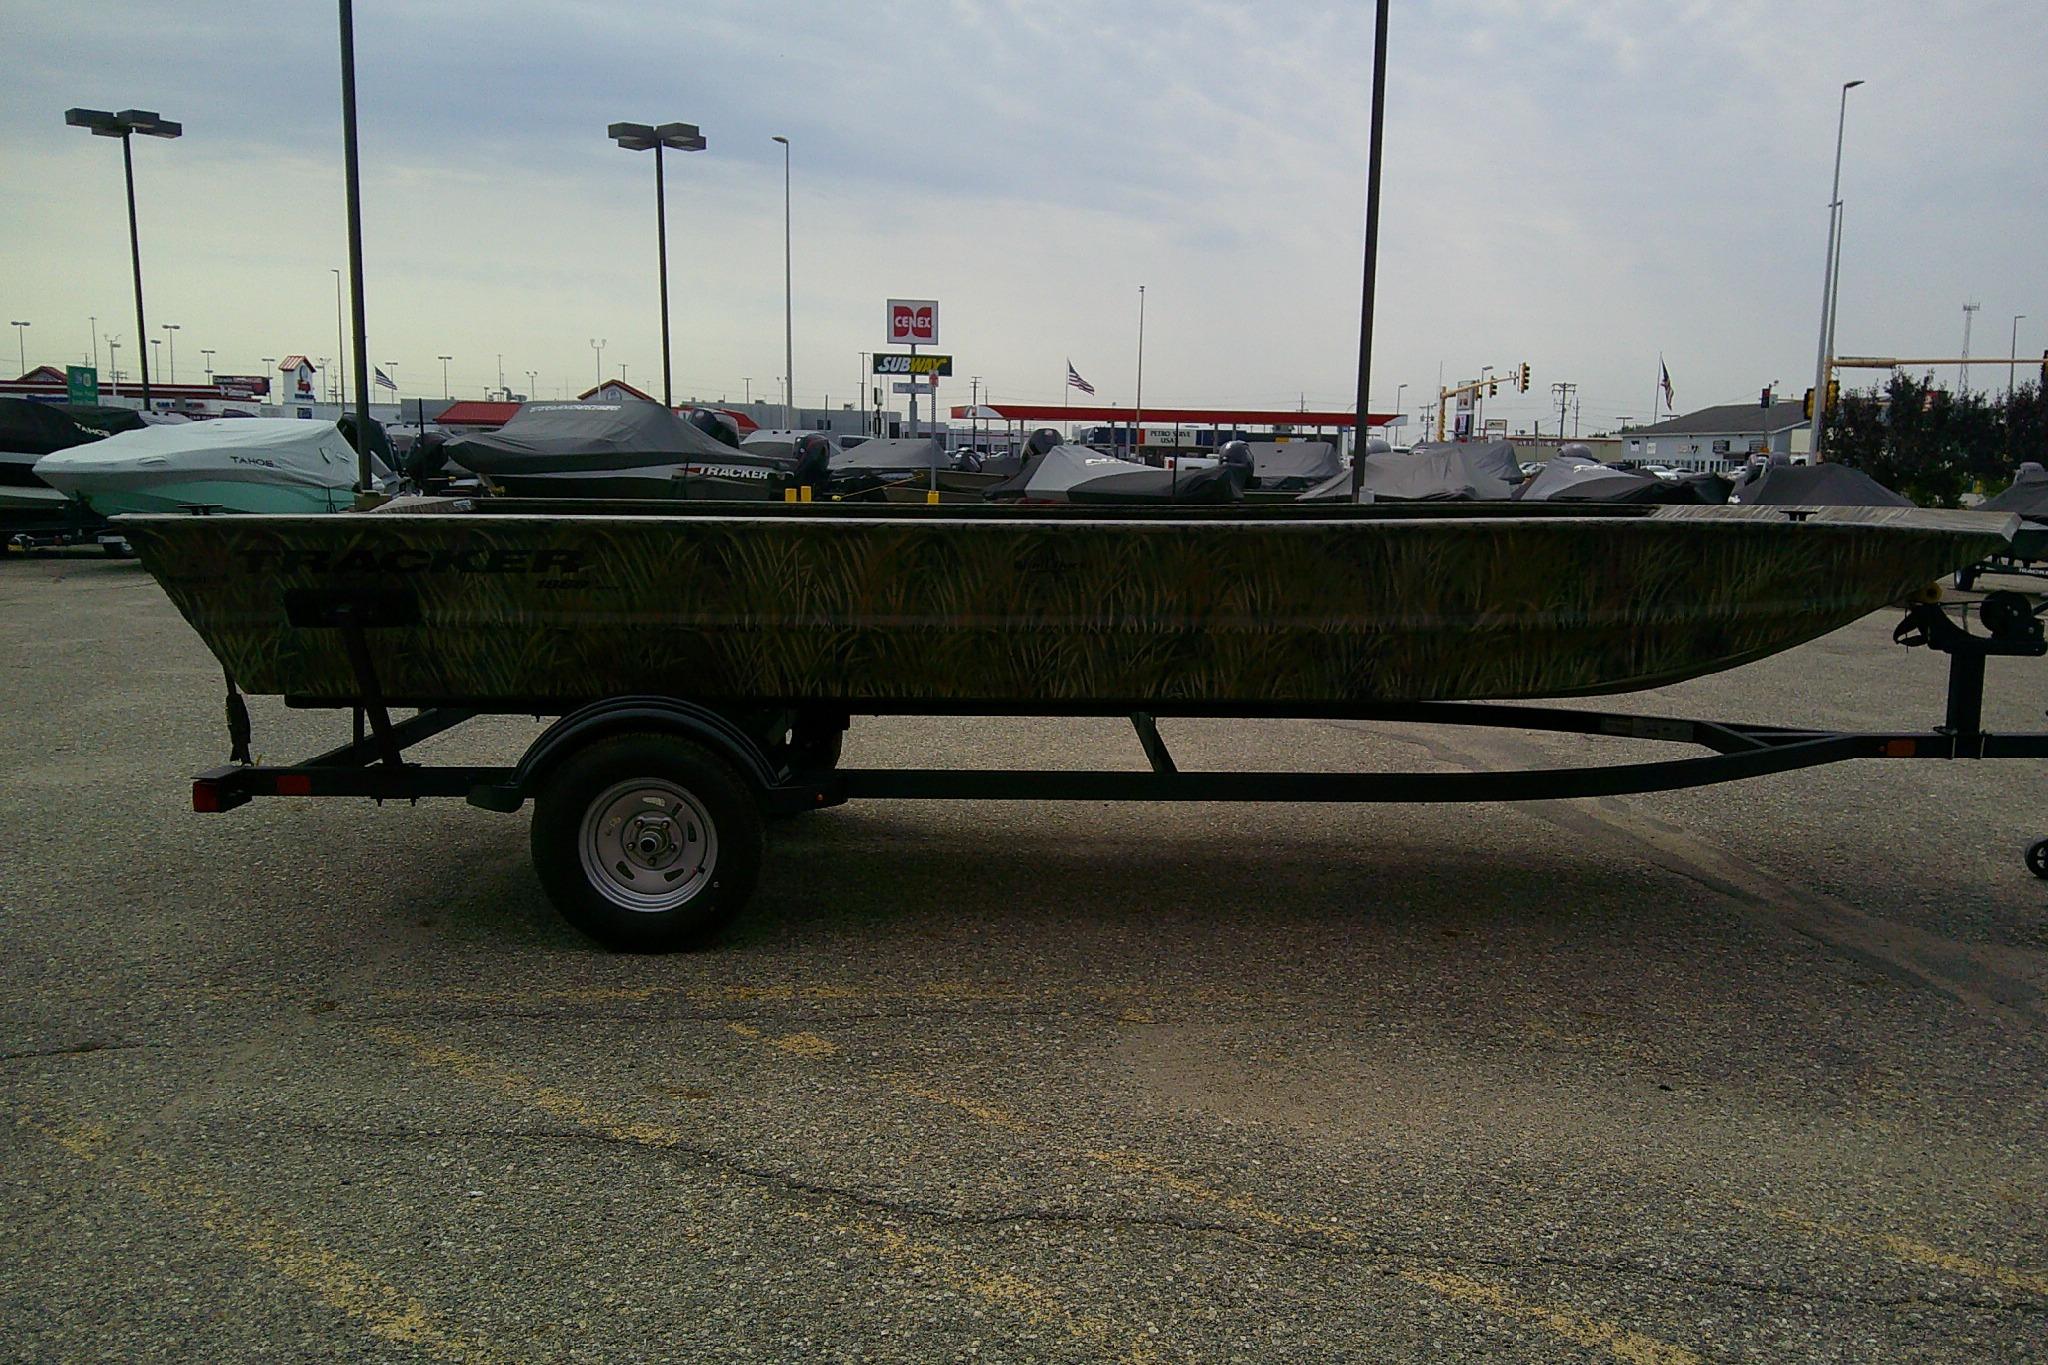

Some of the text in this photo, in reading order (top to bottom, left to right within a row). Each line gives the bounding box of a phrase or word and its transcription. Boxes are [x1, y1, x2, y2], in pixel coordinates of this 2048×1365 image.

[894, 316, 931, 328] CENEX
[877, 356, 947, 373] SUBWAY
[1172, 430, 1191, 438] SRVE
[699, 466, 769, 480] TRACKER
[238, 549, 583, 573] TRACKER
